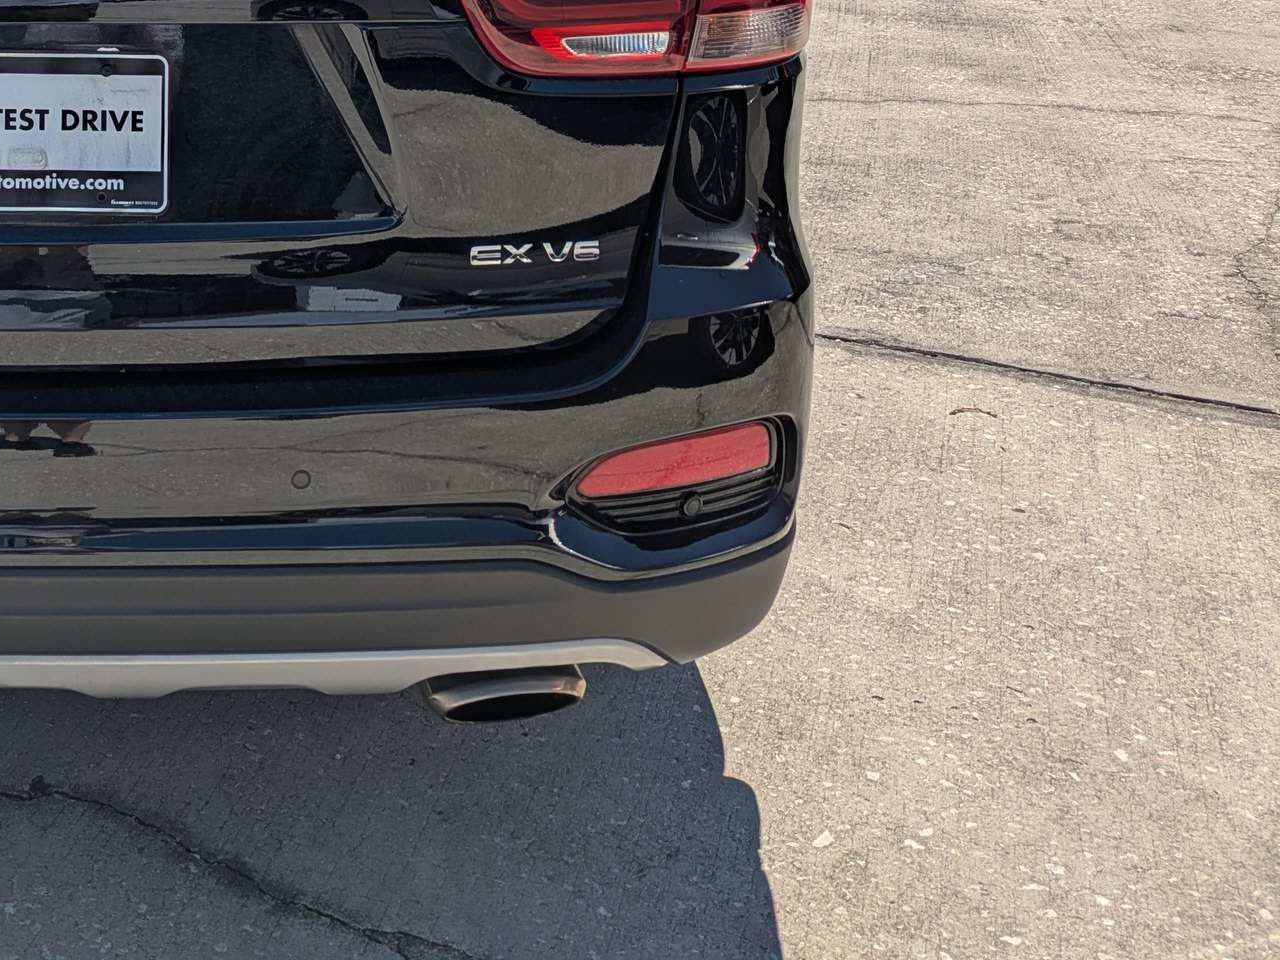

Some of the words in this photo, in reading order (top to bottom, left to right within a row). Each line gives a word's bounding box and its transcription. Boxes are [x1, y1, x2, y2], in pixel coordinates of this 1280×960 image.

[61, 109, 144, 132] DRIVE
[470, 243, 533, 266] EX
[542, 240, 600, 263] V6
